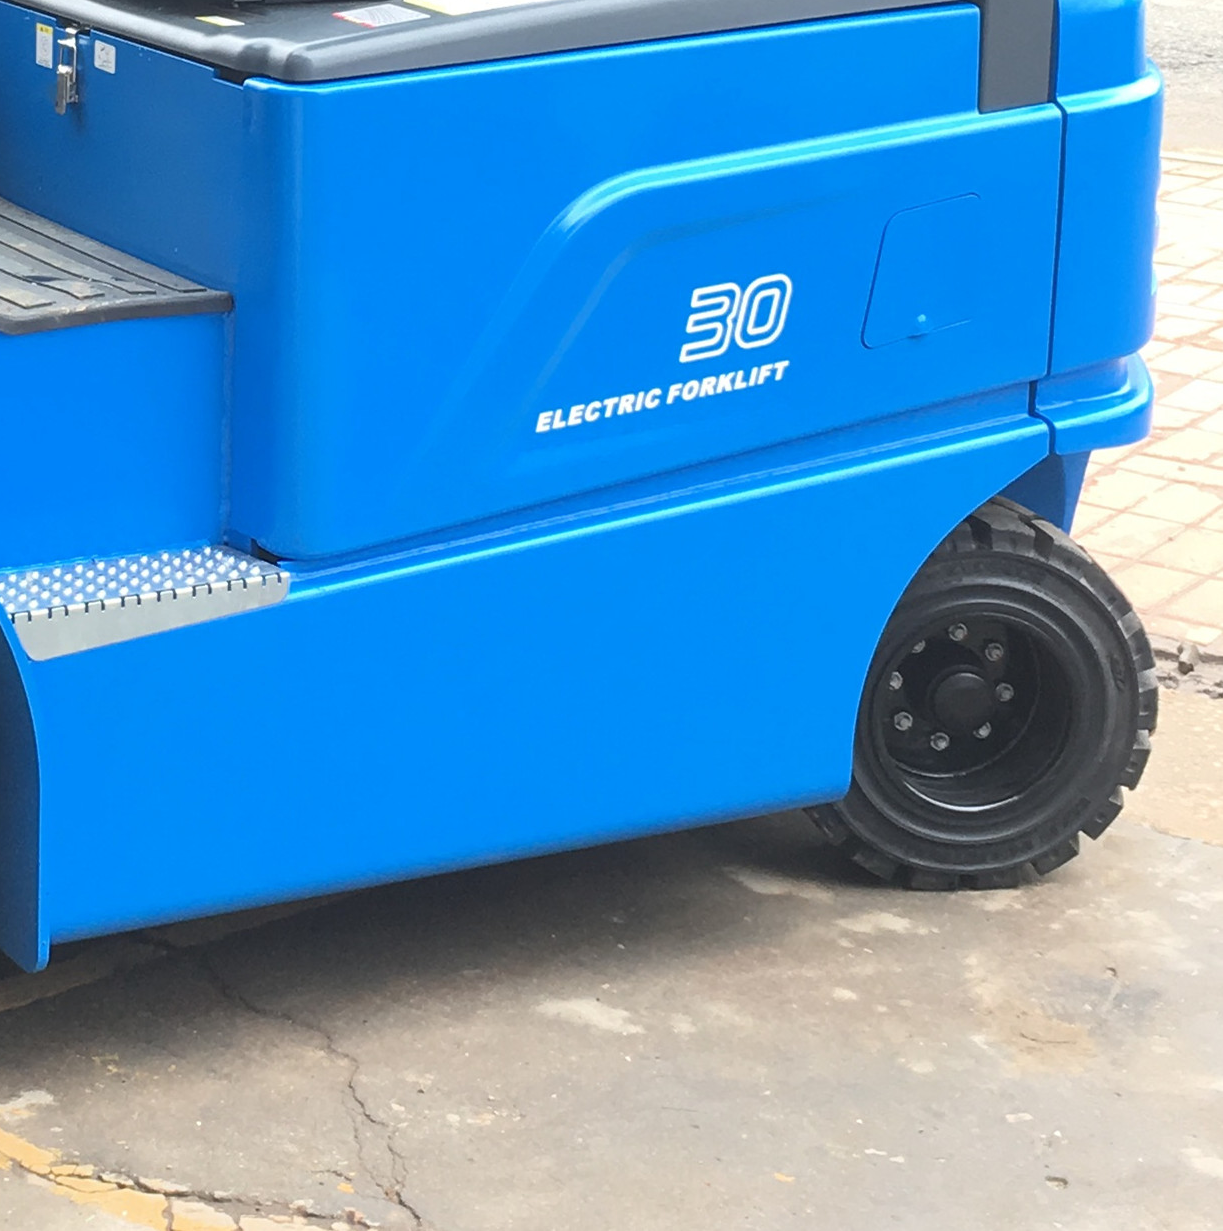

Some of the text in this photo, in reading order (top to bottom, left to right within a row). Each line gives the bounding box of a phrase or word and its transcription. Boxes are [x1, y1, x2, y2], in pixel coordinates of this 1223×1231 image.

[679, 273, 792, 363] 30
[535, 354, 790, 433] ELECTRIC FORKLIFT
